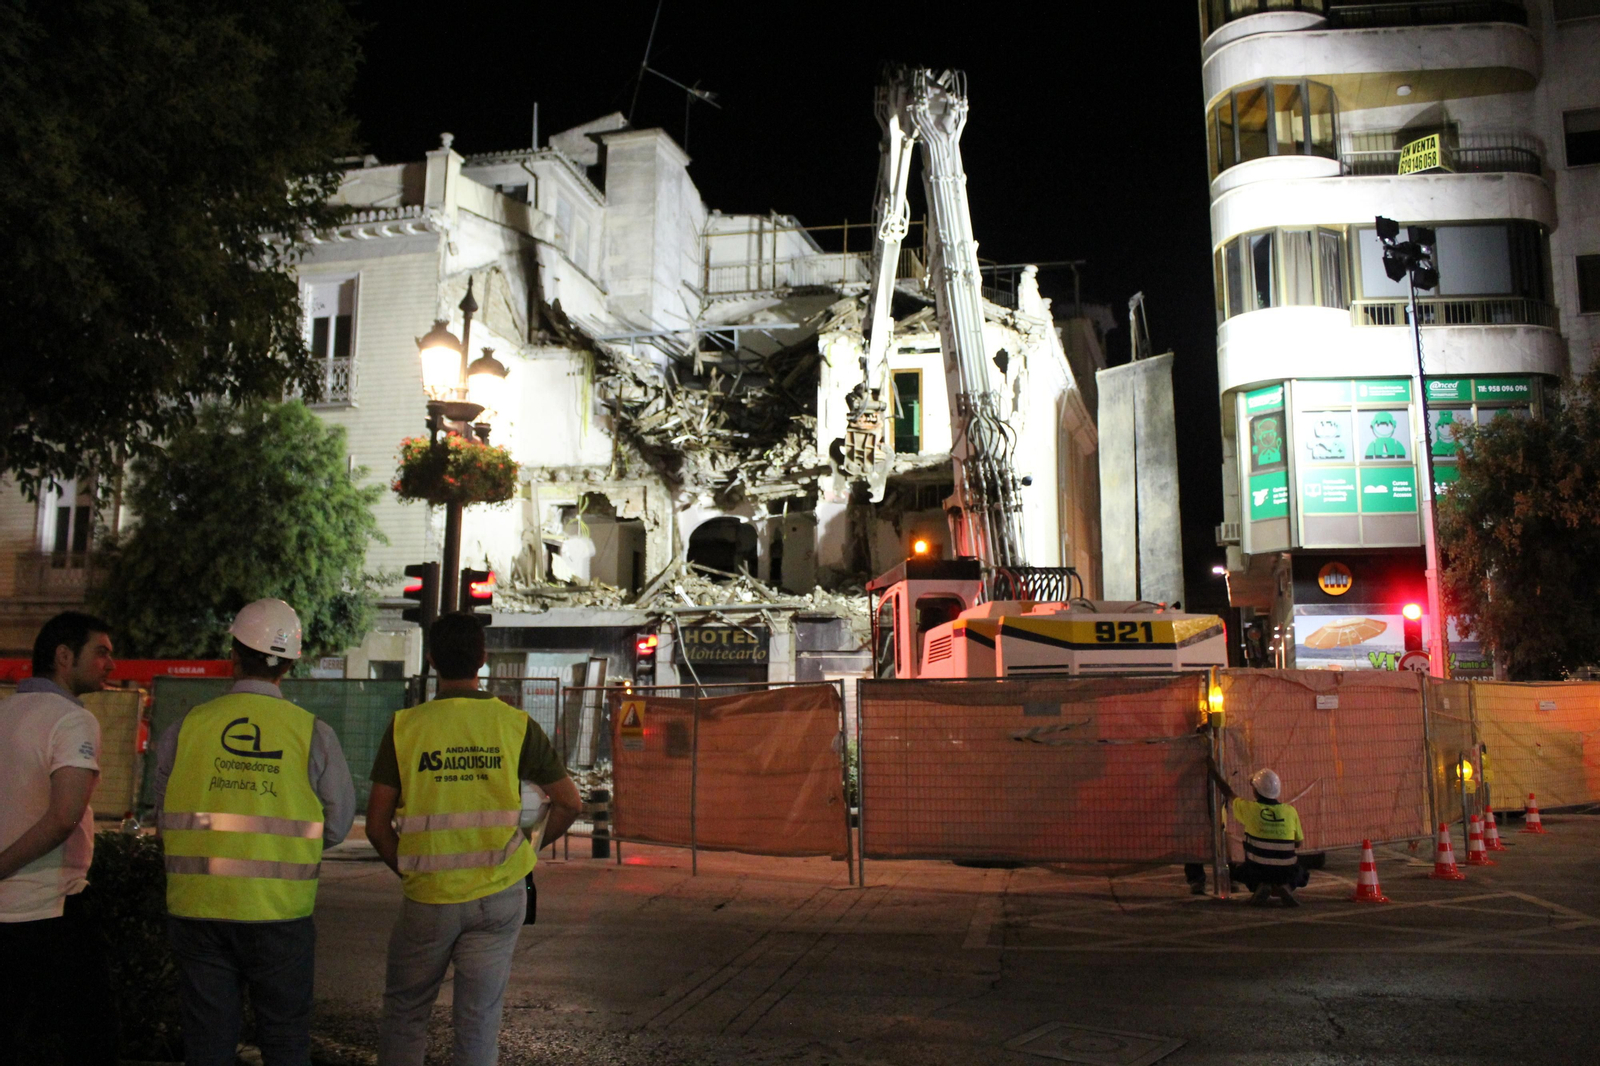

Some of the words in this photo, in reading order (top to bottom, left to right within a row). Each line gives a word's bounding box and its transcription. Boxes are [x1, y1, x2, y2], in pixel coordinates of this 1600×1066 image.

[1402, 144, 1411, 158] EN
[1412, 136, 1436, 154] VENTA
[1423, 151, 1437, 168] 058
[684, 629, 759, 644] HOTEL
[1095, 621, 1153, 642] 921
[682, 645, 767, 660] Montecarlo
[445, 746, 500, 754] ANDAMIAJES
[214, 757, 280, 774] Contenedores
[418, 750, 443, 772] AS
[443, 755, 502, 770] ALQUISUR
